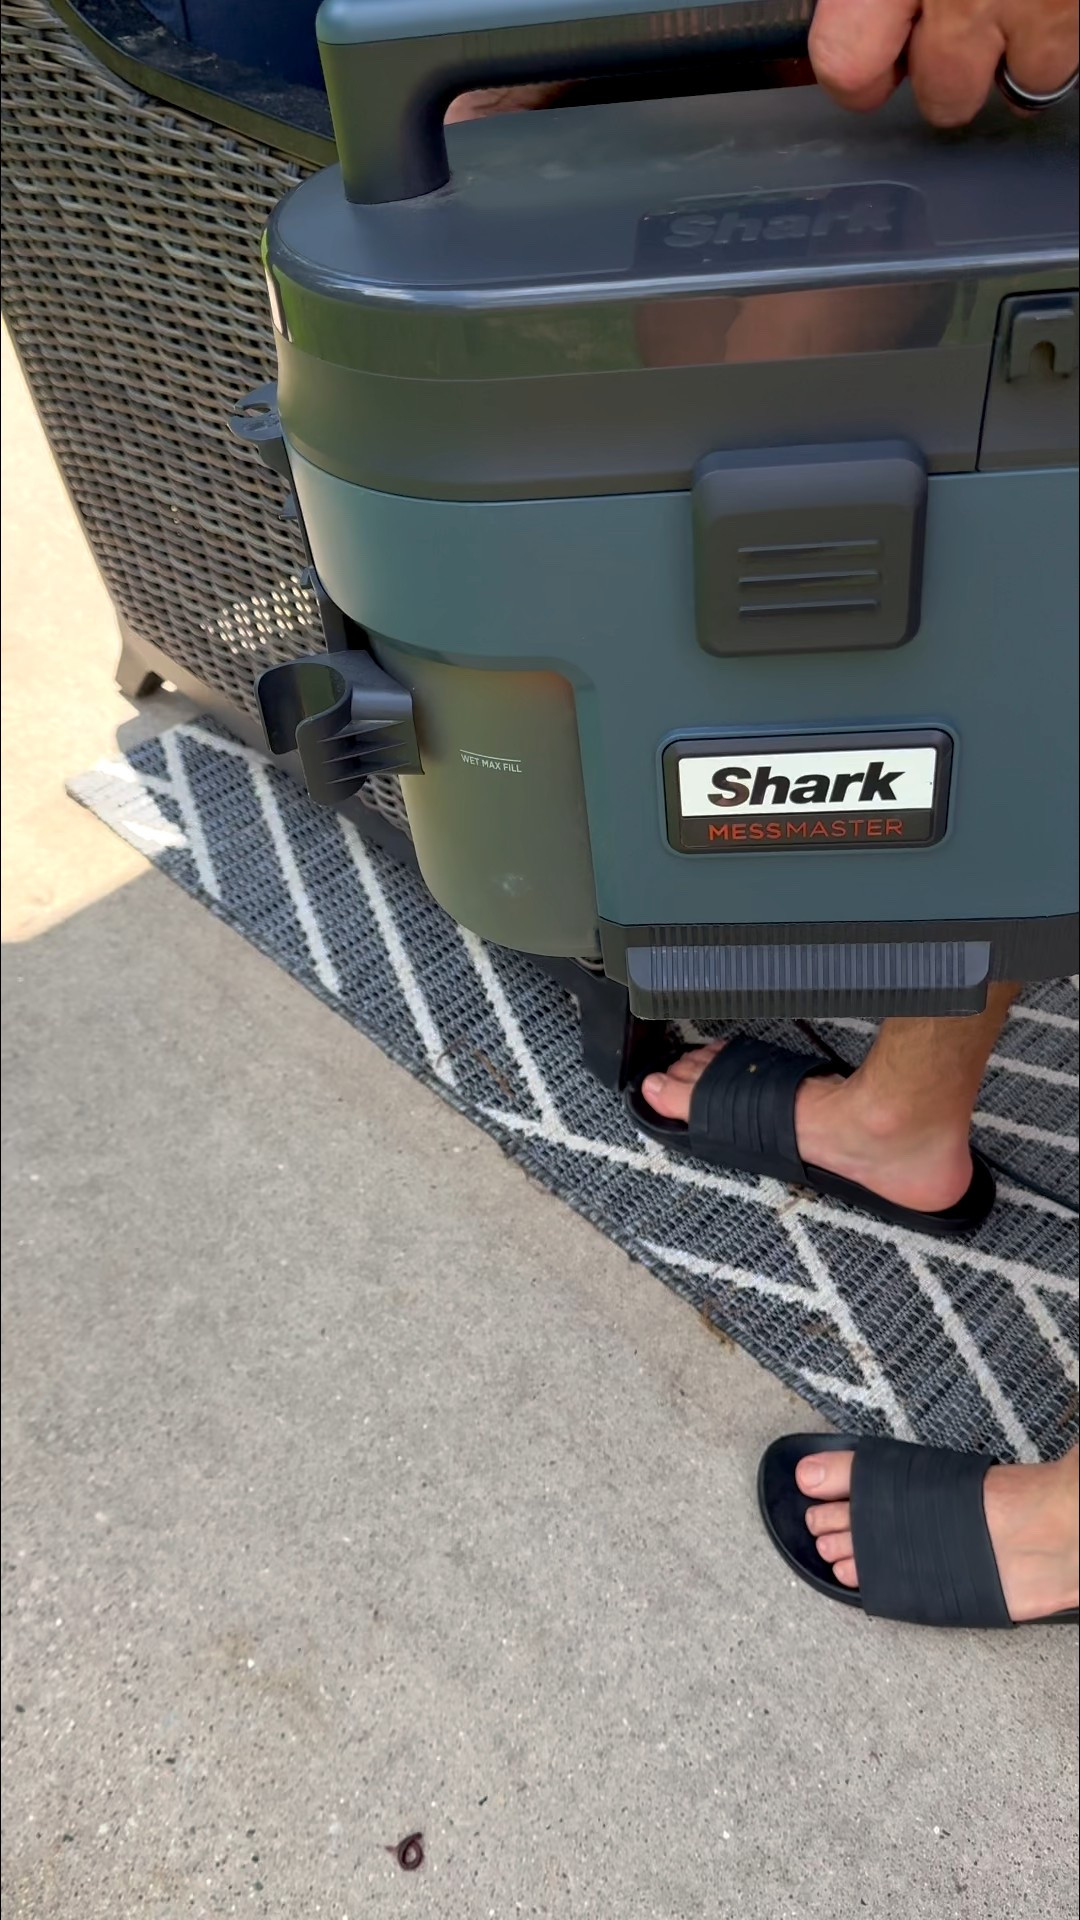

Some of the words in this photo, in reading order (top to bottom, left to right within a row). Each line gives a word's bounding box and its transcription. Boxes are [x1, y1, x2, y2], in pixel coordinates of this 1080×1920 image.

[664, 200, 896, 248] Shark
[460, 753, 479, 766] WET
[482, 759, 501, 770] MAX
[503, 763, 522, 773] FILL
[707, 761, 906, 807] Shark
[708, 818, 905, 840] MESSMASTER
